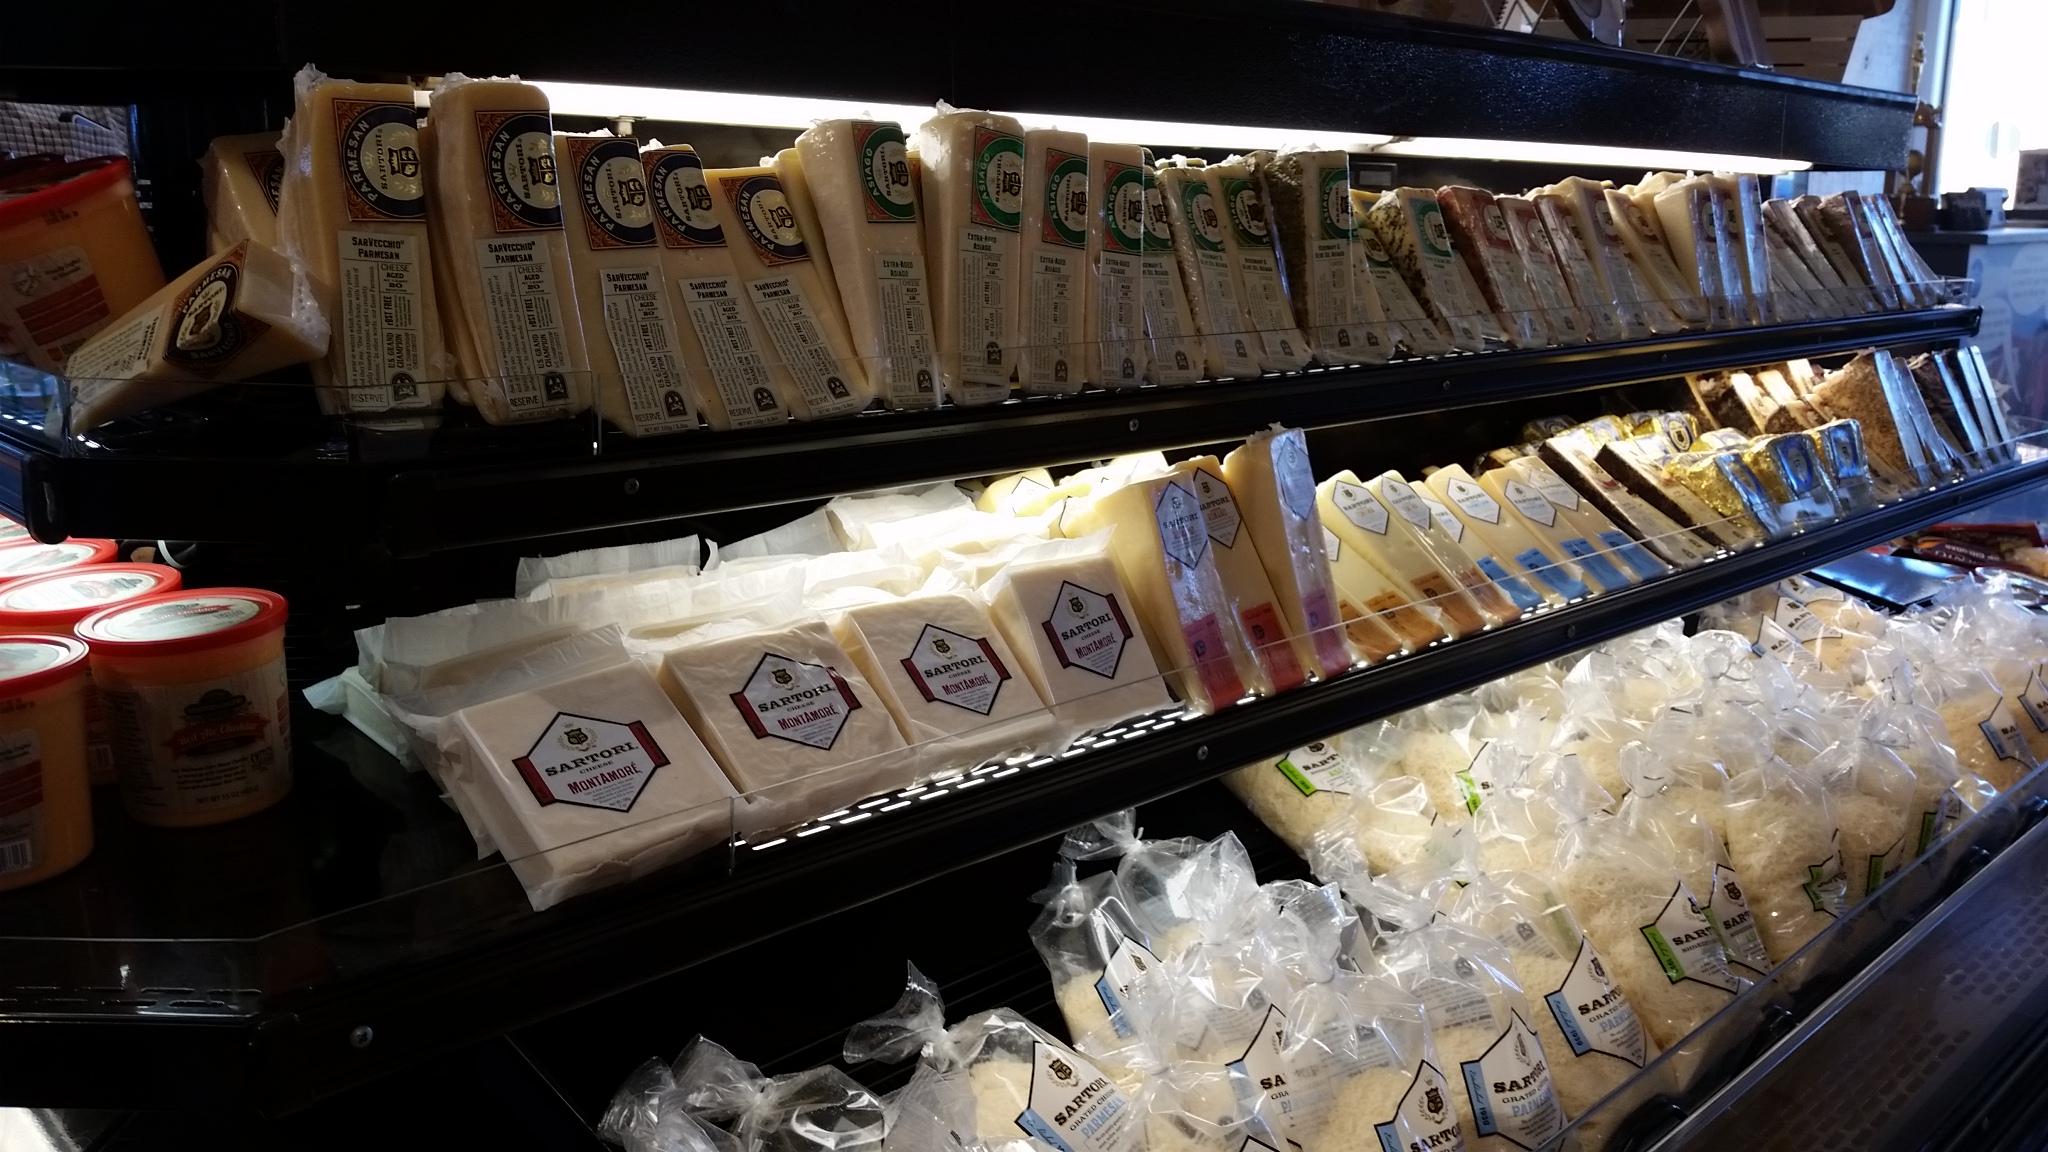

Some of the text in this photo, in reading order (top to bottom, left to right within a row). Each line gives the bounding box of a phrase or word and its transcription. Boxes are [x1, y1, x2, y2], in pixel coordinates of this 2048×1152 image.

[346, 119, 379, 202] PARMESAN
[375, 133, 388, 190] SARTORI
[491, 130, 523, 212] PARMESAN
[864, 148, 880, 196] ASIAGO
[978, 153, 991, 200] ASIAGO
[583, 155, 615, 231] PARMESAN
[653, 166, 686, 232] PARMESAN
[1049, 174, 1060, 220] ASIAGO
[741, 190, 775, 251] PARMESAN
[1107, 186, 1118, 229] ASIAGO
[358, 248, 401, 260] PARMESAN
[380, 263, 410, 273] CHEESE
[495, 253, 534, 264] PARMESAN
[386, 272, 404, 280] AGED
[518, 265, 545, 274] CHEESE
[613, 283, 648, 293] PARMESAN
[697, 290, 728, 299] PARMESAN
[383, 295, 392, 310] FREE
[386, 332, 395, 356] GRAND
[395, 334, 405, 368] CHAMPION
[532, 333, 542, 357] GRAND
[540, 334, 552, 368] CHAMPION
[1061, 613, 1113, 641] SARTORI
[1081, 629, 1101, 641] CHEESE
[924, 655, 986, 679] SARTORI
[948, 669, 972, 679] CHEESE
[757, 683, 834, 713] SARTORI
[786, 700, 815, 713] CHEESE
[777, 703, 839, 731] MONTAMORÉ
[545, 741, 635, 777] SARTORI
[579, 760, 614, 775] CHEESE
[1302, 754, 1340, 771] SART
[567, 761, 641, 795] MONTAMORÉ
[1570, 1030, 1583, 1046] 1939
[1054, 1077, 1109, 1126] SARTORI
[1069, 1104, 1098, 1132] GRATED
[1080, 1095, 1126, 1139] PARMESAN
[1479, 1106, 1490, 1126] 1939
